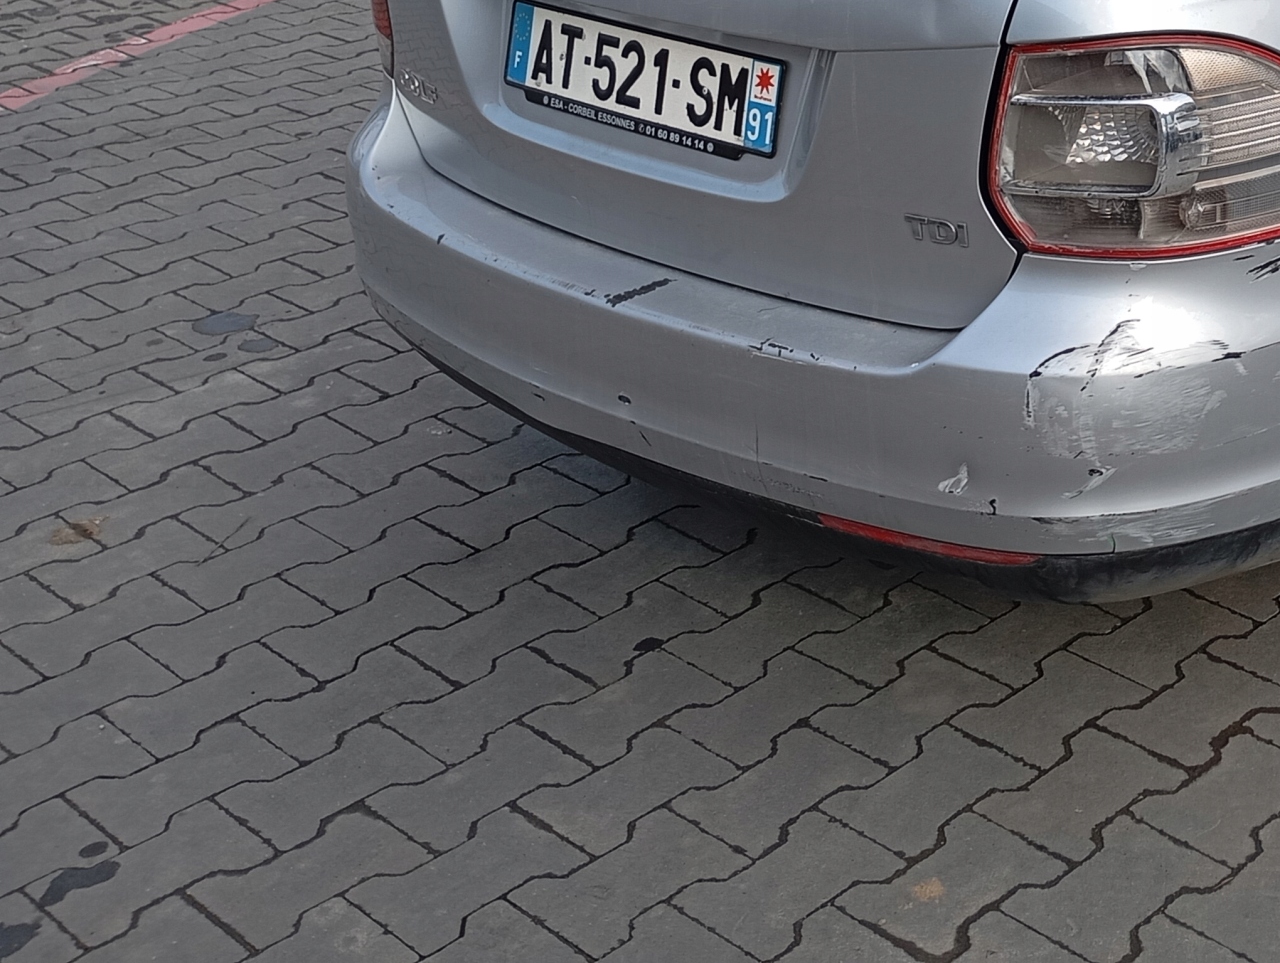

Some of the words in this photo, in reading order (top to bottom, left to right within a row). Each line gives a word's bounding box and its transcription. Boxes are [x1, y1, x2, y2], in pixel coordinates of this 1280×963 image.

[514, 50, 523, 68] F
[550, 98, 564, 110] ESA
[568, 103, 597, 120] CORBEIL
[597, 112, 635, 130] ESSONNES
[645, 125, 656, 137] 01
[657, 129, 668, 140] 60
[669, 132, 680, 143] 89
[682, 136, 692, 147] 14
[694, 139, 704, 150] 14
[746, 108, 774, 145] 91
[904, 213, 969, 248] TDI
